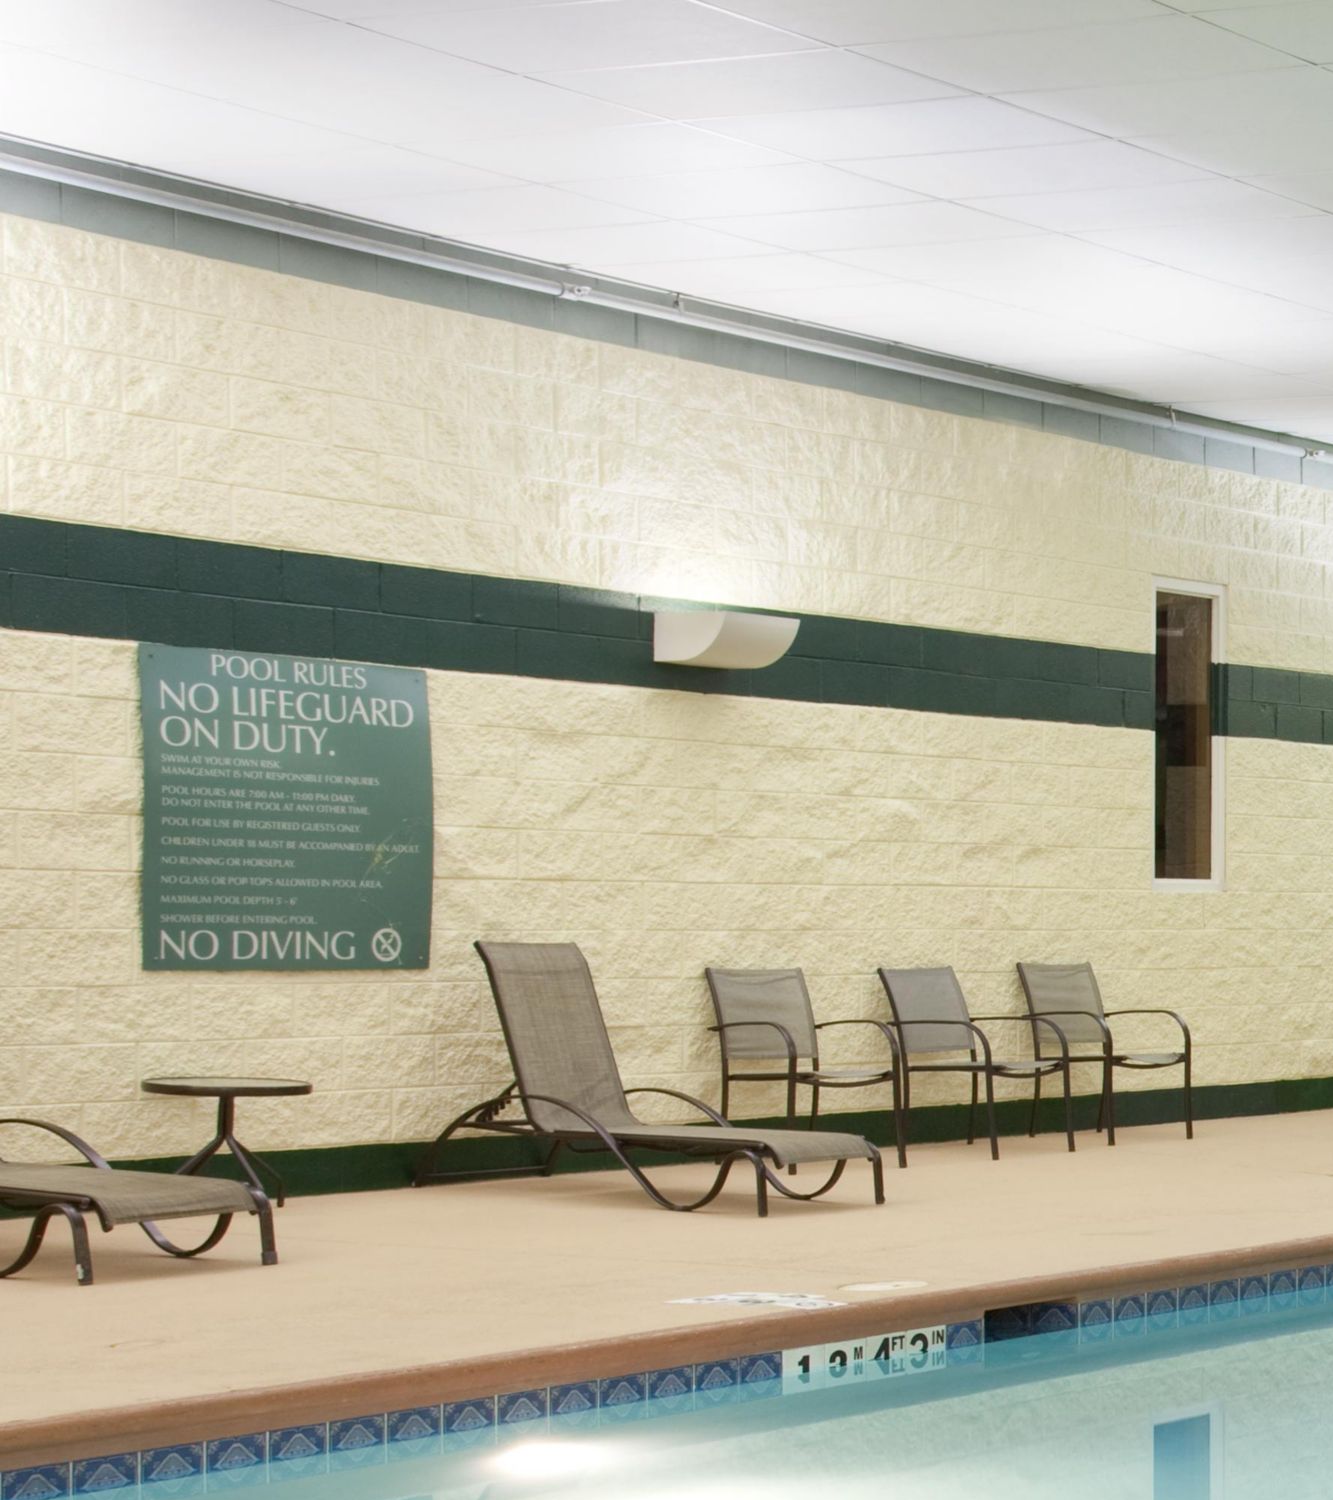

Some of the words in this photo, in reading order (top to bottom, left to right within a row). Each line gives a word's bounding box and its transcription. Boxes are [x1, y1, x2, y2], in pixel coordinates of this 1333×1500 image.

[210, 653, 287, 683] POOL
[293, 661, 368, 690] RULES
[159, 679, 220, 714] NO
[231, 686, 415, 728] LIFEGUARD
[159, 715, 219, 749] ON
[233, 720, 336, 757] DUTY.
[160, 753, 190, 764] SWIM
[191, 755, 202, 765] AT
[204, 756, 232, 766] YOUR
[233, 758, 258, 767] OWN
[160, 766, 231, 778] MANAGEMENT
[233, 769, 241, 778] IS
[243, 770, 263, 780] NOT
[265, 771, 322, 783] RESPONSIBLE
[325, 774, 343, 784] FOR
[161, 785, 189, 795] POOL
[192, 786, 226, 797] HOURS
[229, 788, 246, 798] ARE
[268, 790, 284, 799] AM
[315, 792, 330, 802] PM
[161, 797, 179, 807] DO
[181, 798, 201, 808] NOT
[204, 799, 233, 809] ENTER
[236, 800, 253, 810] THE
[254, 801, 280, 812] POOL
[282, 802, 294, 812] AT
[296, 803, 315, 813] ANY
[316, 804, 347, 814] OTHER
[161, 816, 189, 827] POOL
[191, 817, 211, 828] FOR
[213, 818, 231, 829] USE
[232, 819, 244, 829] BY
[246, 820, 300, 831] REGISTERED
[302, 822, 336, 832] GUESTS
[161, 836, 210, 847] CHILDREN
[211, 838, 245, 848] UNDER
[258, 840, 284, 849] MUST
[286, 840, 296, 850] BE
[299, 841, 364, 852] ACCOMPANIED
[161, 855, 178, 865] NO
[179, 855, 225, 866] RUNNING
[226, 857, 240, 867] OR
[161, 875, 178, 885] NO
[179, 875, 210, 885] GLASS
[211, 876, 226, 886] OR
[227, 876, 248, 886] POP
[249, 876, 273, 887] TOPS
[274, 877, 320, 888] ALLOWED
[320, 879, 330, 888] IN
[332, 879, 357, 889] POOL
[160, 894, 212, 905] MAXIMUM
[213, 895, 240, 905] POOL
[242, 896, 274, 905] DEPTH
[160, 913, 204, 924] SHOWER
[205, 914, 241, 924] BEFORE
[242, 915, 288, 925] ENTERING
[158, 928, 220, 961] NO
[231, 929, 357, 961] DIVING
[853, 1345, 864, 1361] M
[891, 1335, 906, 1352] FT
[931, 1329, 945, 1346] IN
